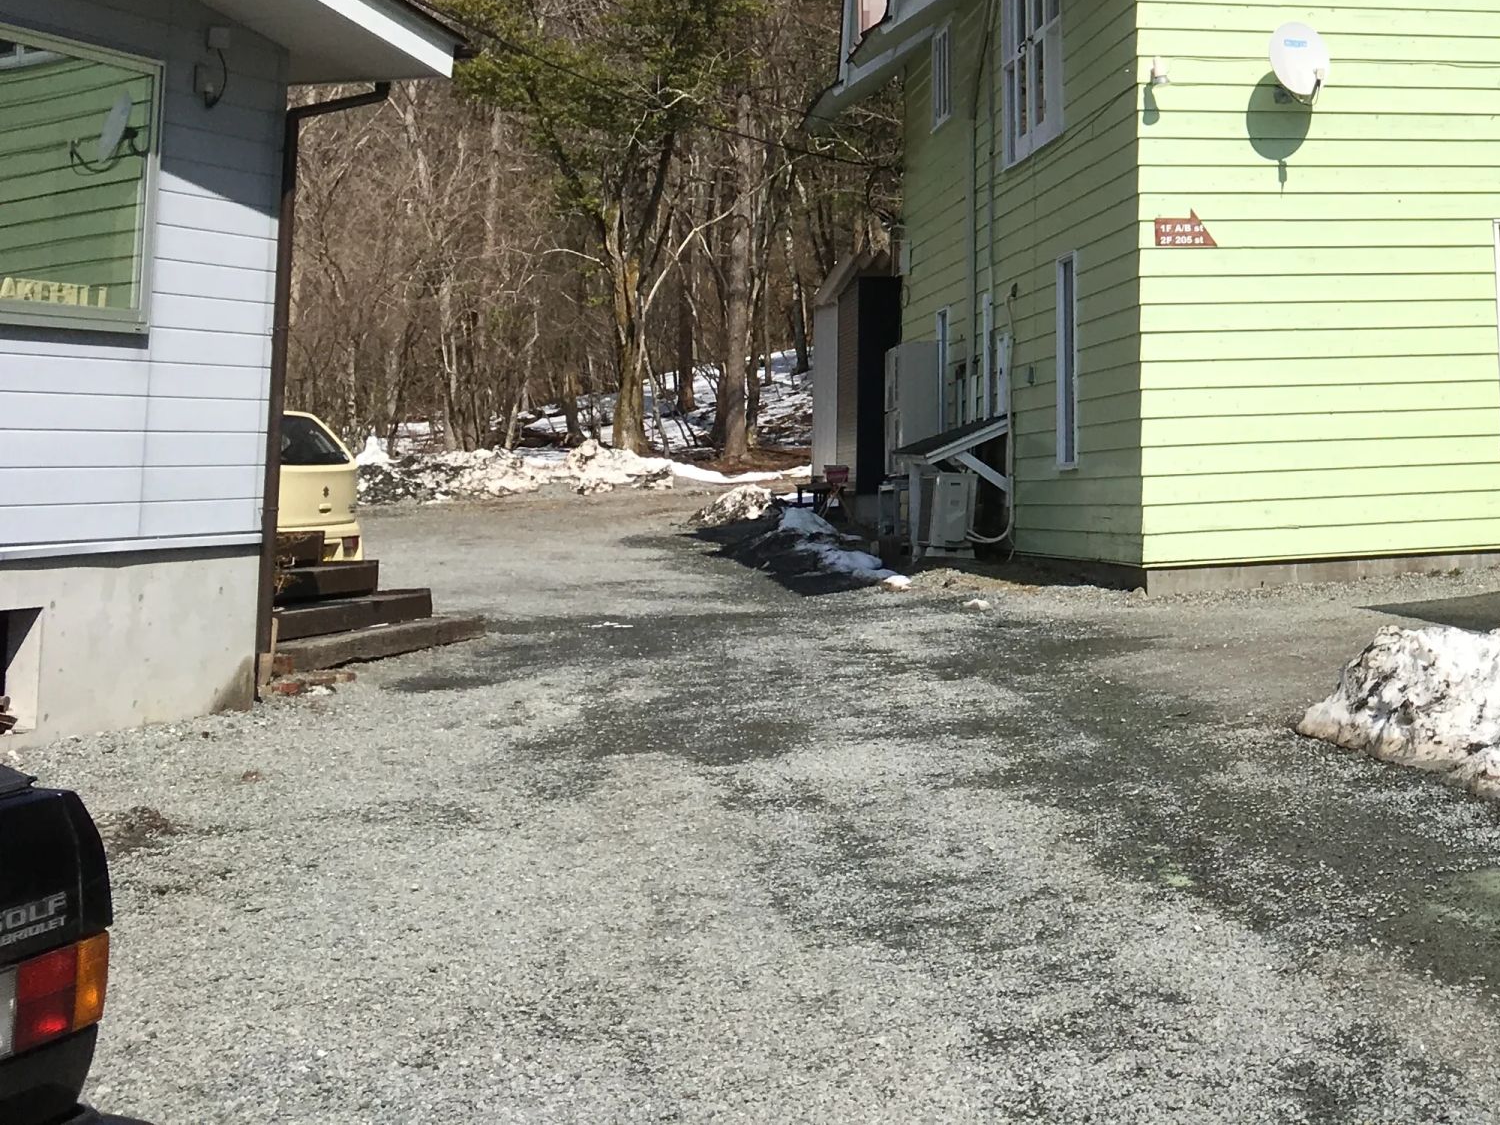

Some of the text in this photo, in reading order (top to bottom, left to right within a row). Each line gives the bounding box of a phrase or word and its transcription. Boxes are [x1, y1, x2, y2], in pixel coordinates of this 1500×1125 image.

[1160, 224, 1172, 232] 1F
[1175, 224, 1191, 232] A/B
[0, 891, 67, 931] OLF
